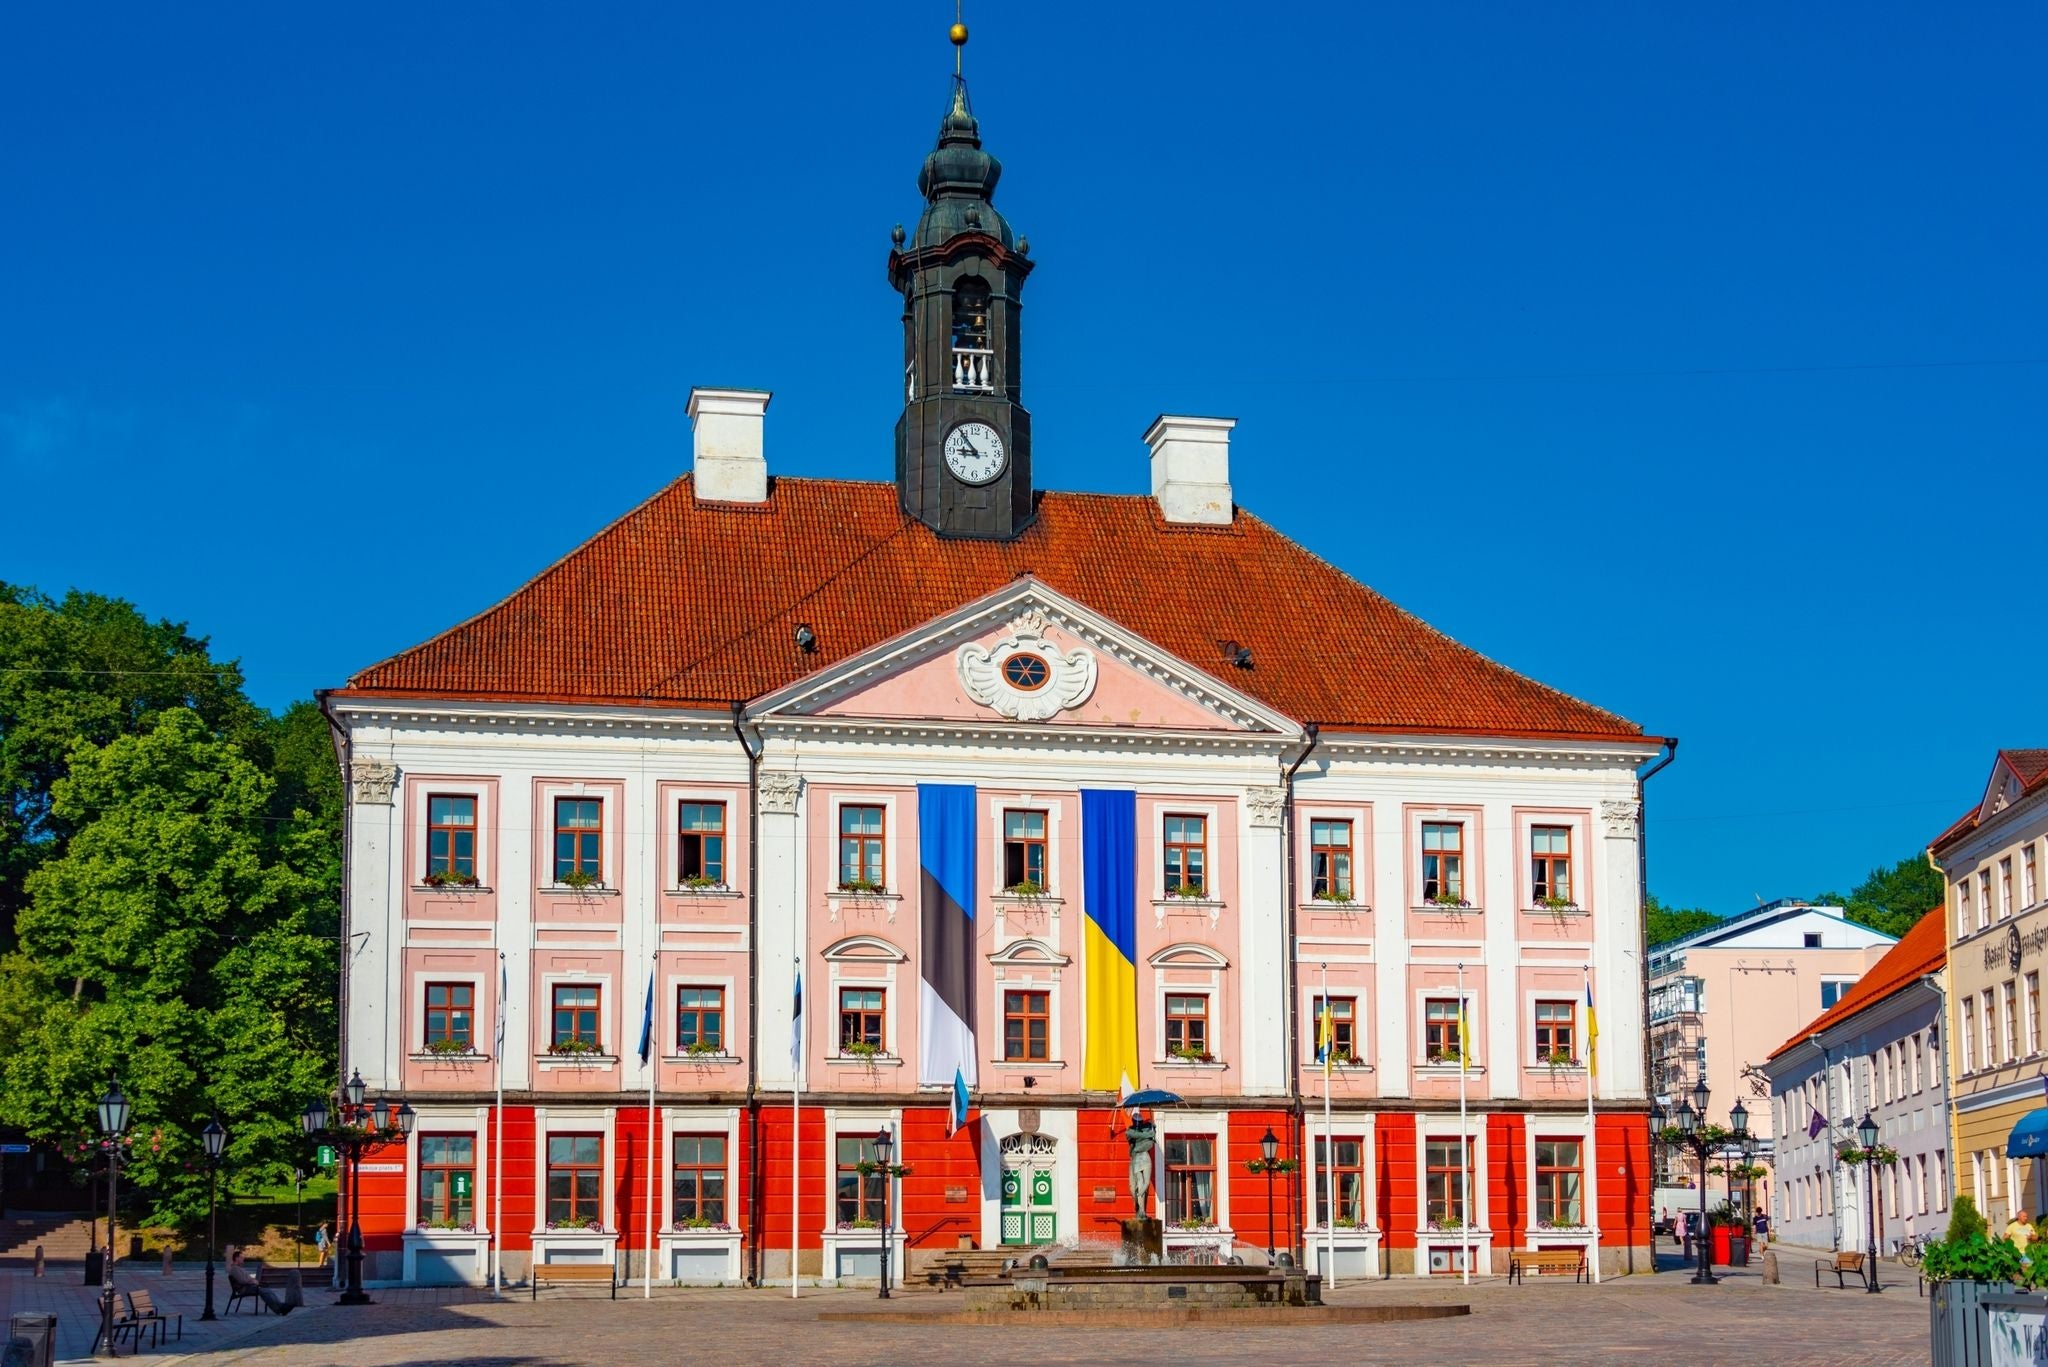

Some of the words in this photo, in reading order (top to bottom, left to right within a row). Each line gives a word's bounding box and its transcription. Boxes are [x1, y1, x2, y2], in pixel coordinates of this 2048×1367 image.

[970, 427, 980, 436] 12
[952, 438, 963, 447] 10
[991, 439, 998, 448] 2
[949, 447, 956, 455] 9
[994, 450, 1001, 458] 3
[952, 457, 959, 465] 8
[991, 460, 997, 468] 4
[960, 465, 966, 476] 7
[971, 470, 978, 478] 6
[984, 467, 991, 476] 5
